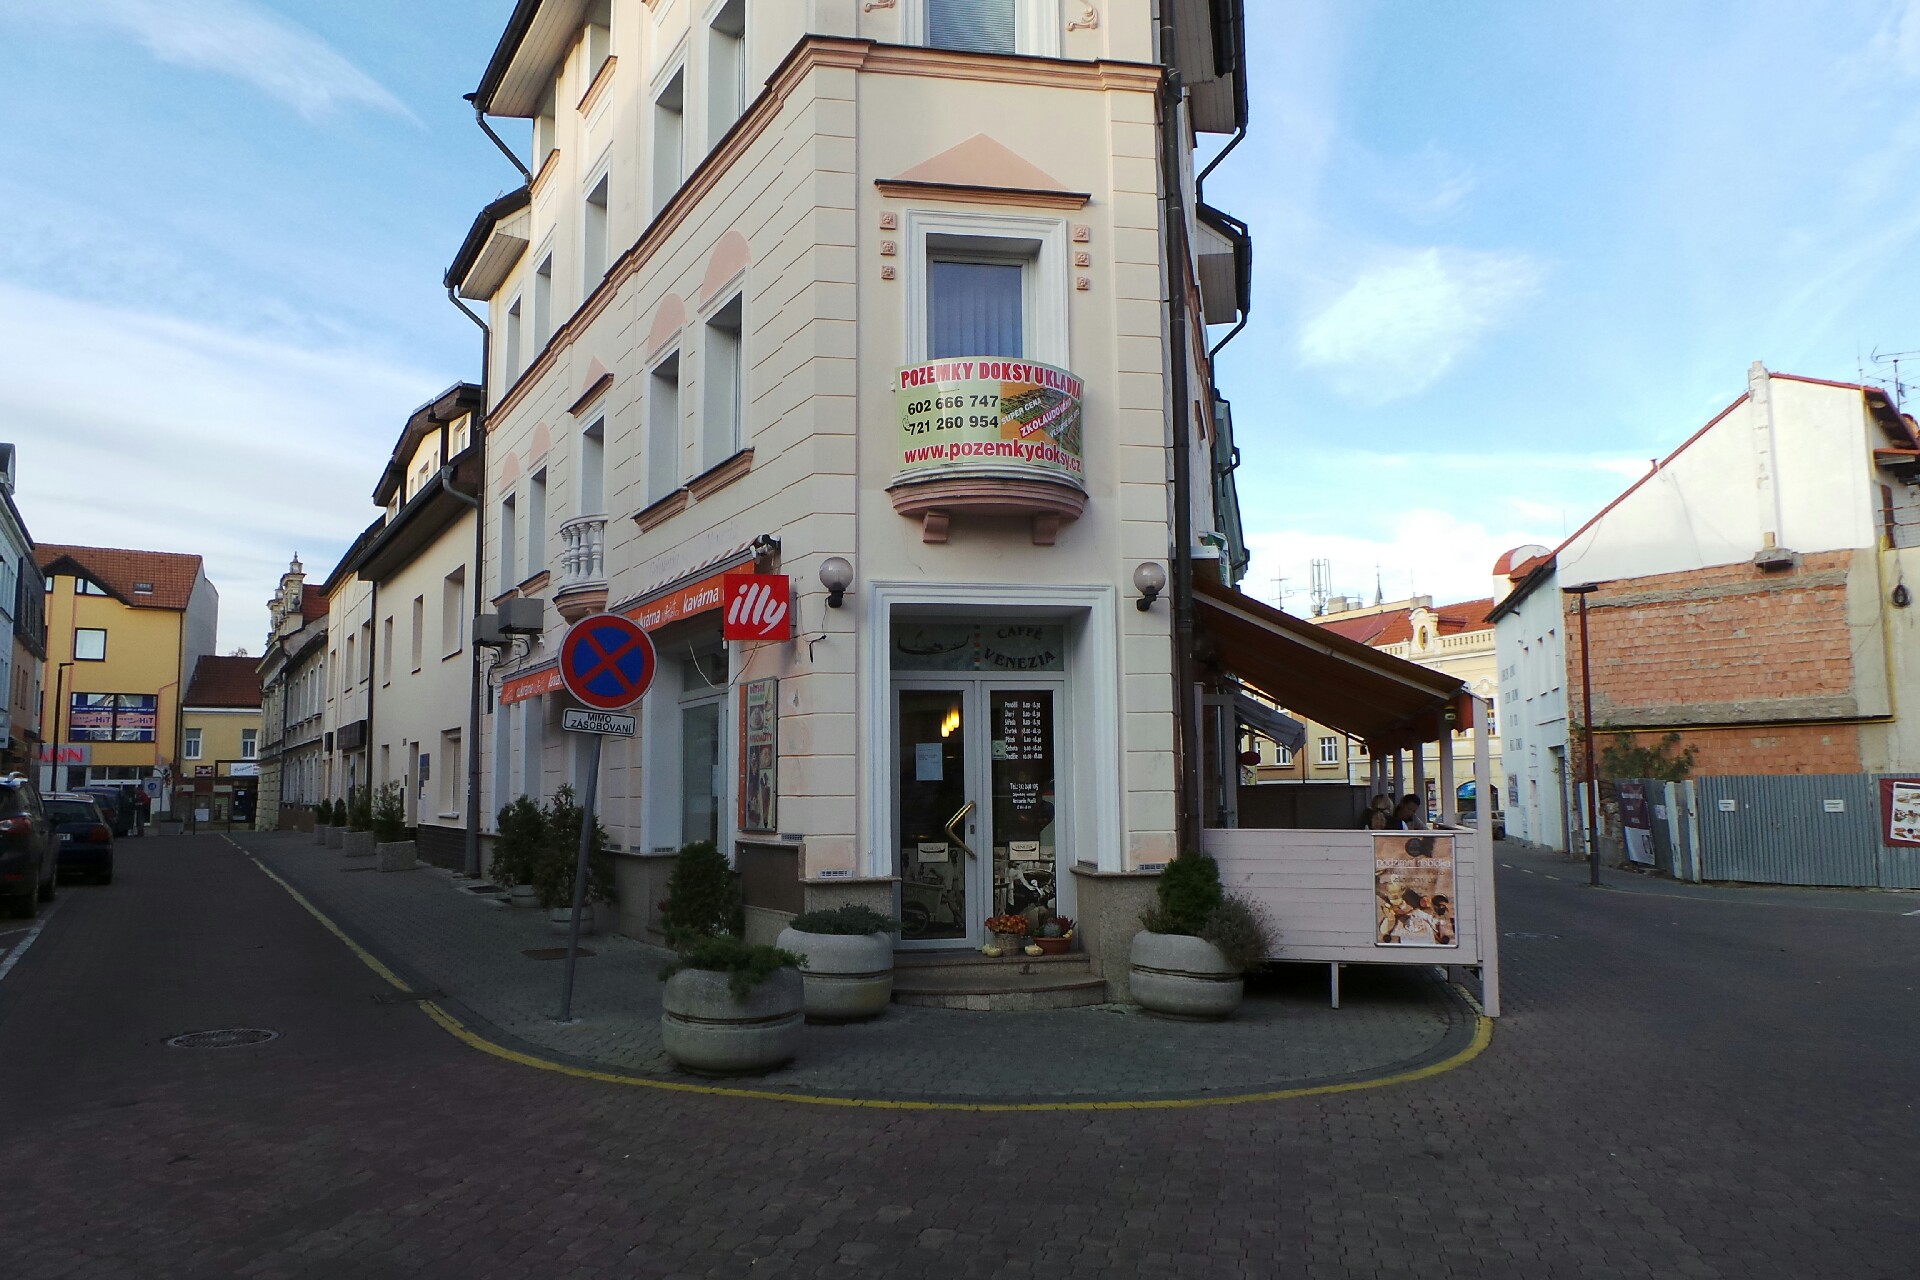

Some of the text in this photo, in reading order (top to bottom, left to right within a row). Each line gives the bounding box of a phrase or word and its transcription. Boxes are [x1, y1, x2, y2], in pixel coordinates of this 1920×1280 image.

[901, 362, 974, 389] POZEMKY
[979, 362, 1032, 383] DOKSY
[1034, 365, 1044, 385] U
[907, 395, 999, 415] 602 666 747
[1001, 407, 1025, 425] SUPER
[909, 416, 999, 435] 721 260 954
[904, 439, 1082, 473] www.pozemkydoksy.cz
[682, 586, 719, 614] kavárna
[728, 582, 788, 635] illy
[984, 647, 1056, 669] VENEZIA
[587, 713, 612, 724] MIMO
